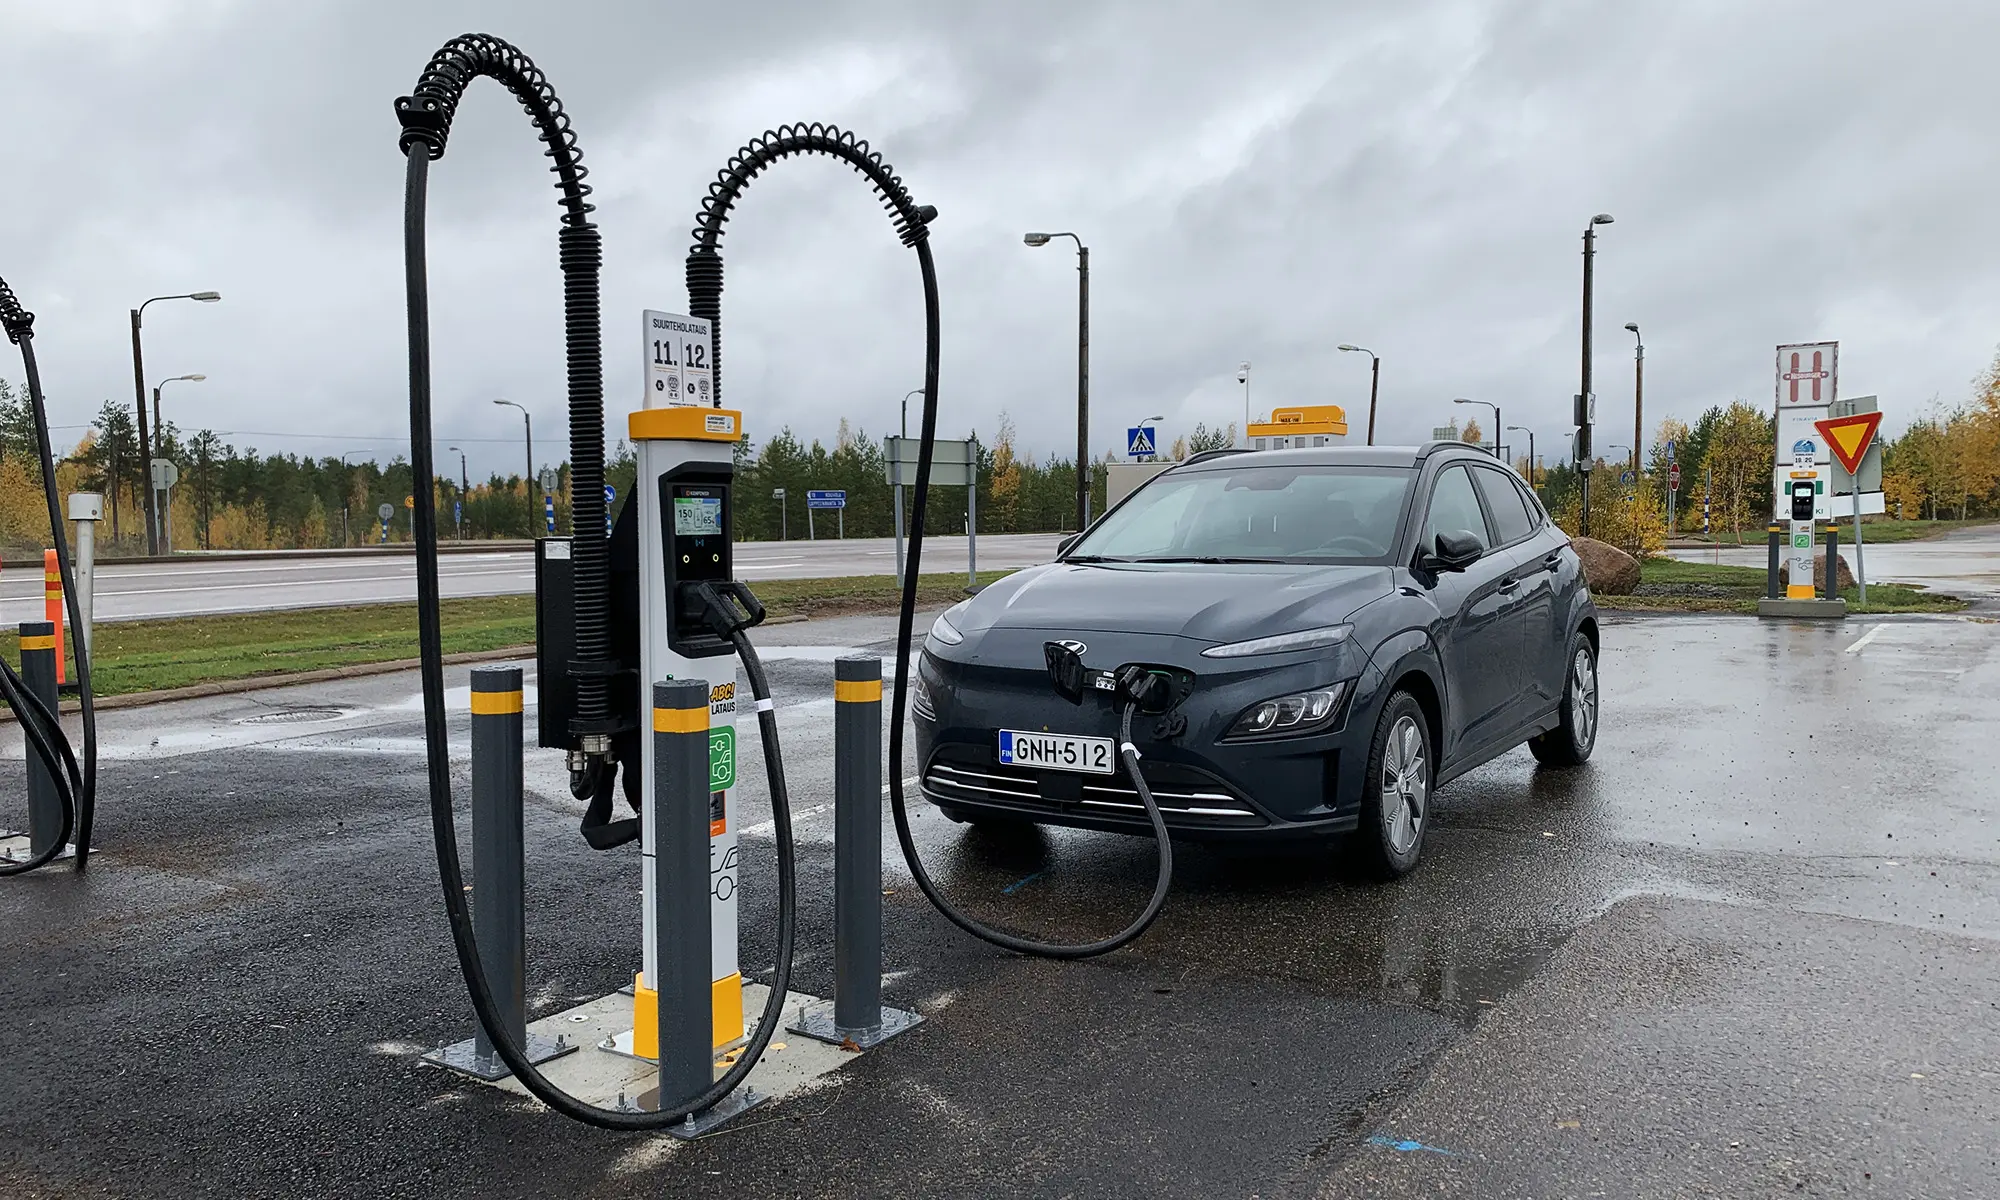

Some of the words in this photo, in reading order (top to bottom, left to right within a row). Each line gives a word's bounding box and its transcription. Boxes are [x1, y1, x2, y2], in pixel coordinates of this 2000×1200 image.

[652, 318, 708, 335] SUURTEHOLATAUS
[653, 340, 678, 366] 11.
[685, 343, 710, 369] 12.
[678, 509, 693, 518] 150
[709, 681, 736, 703] ABC!
[711, 701, 736, 715] LATAUS
[1001, 749, 1012, 757] FIN
[1016, 737, 1107, 768] GNH-512
